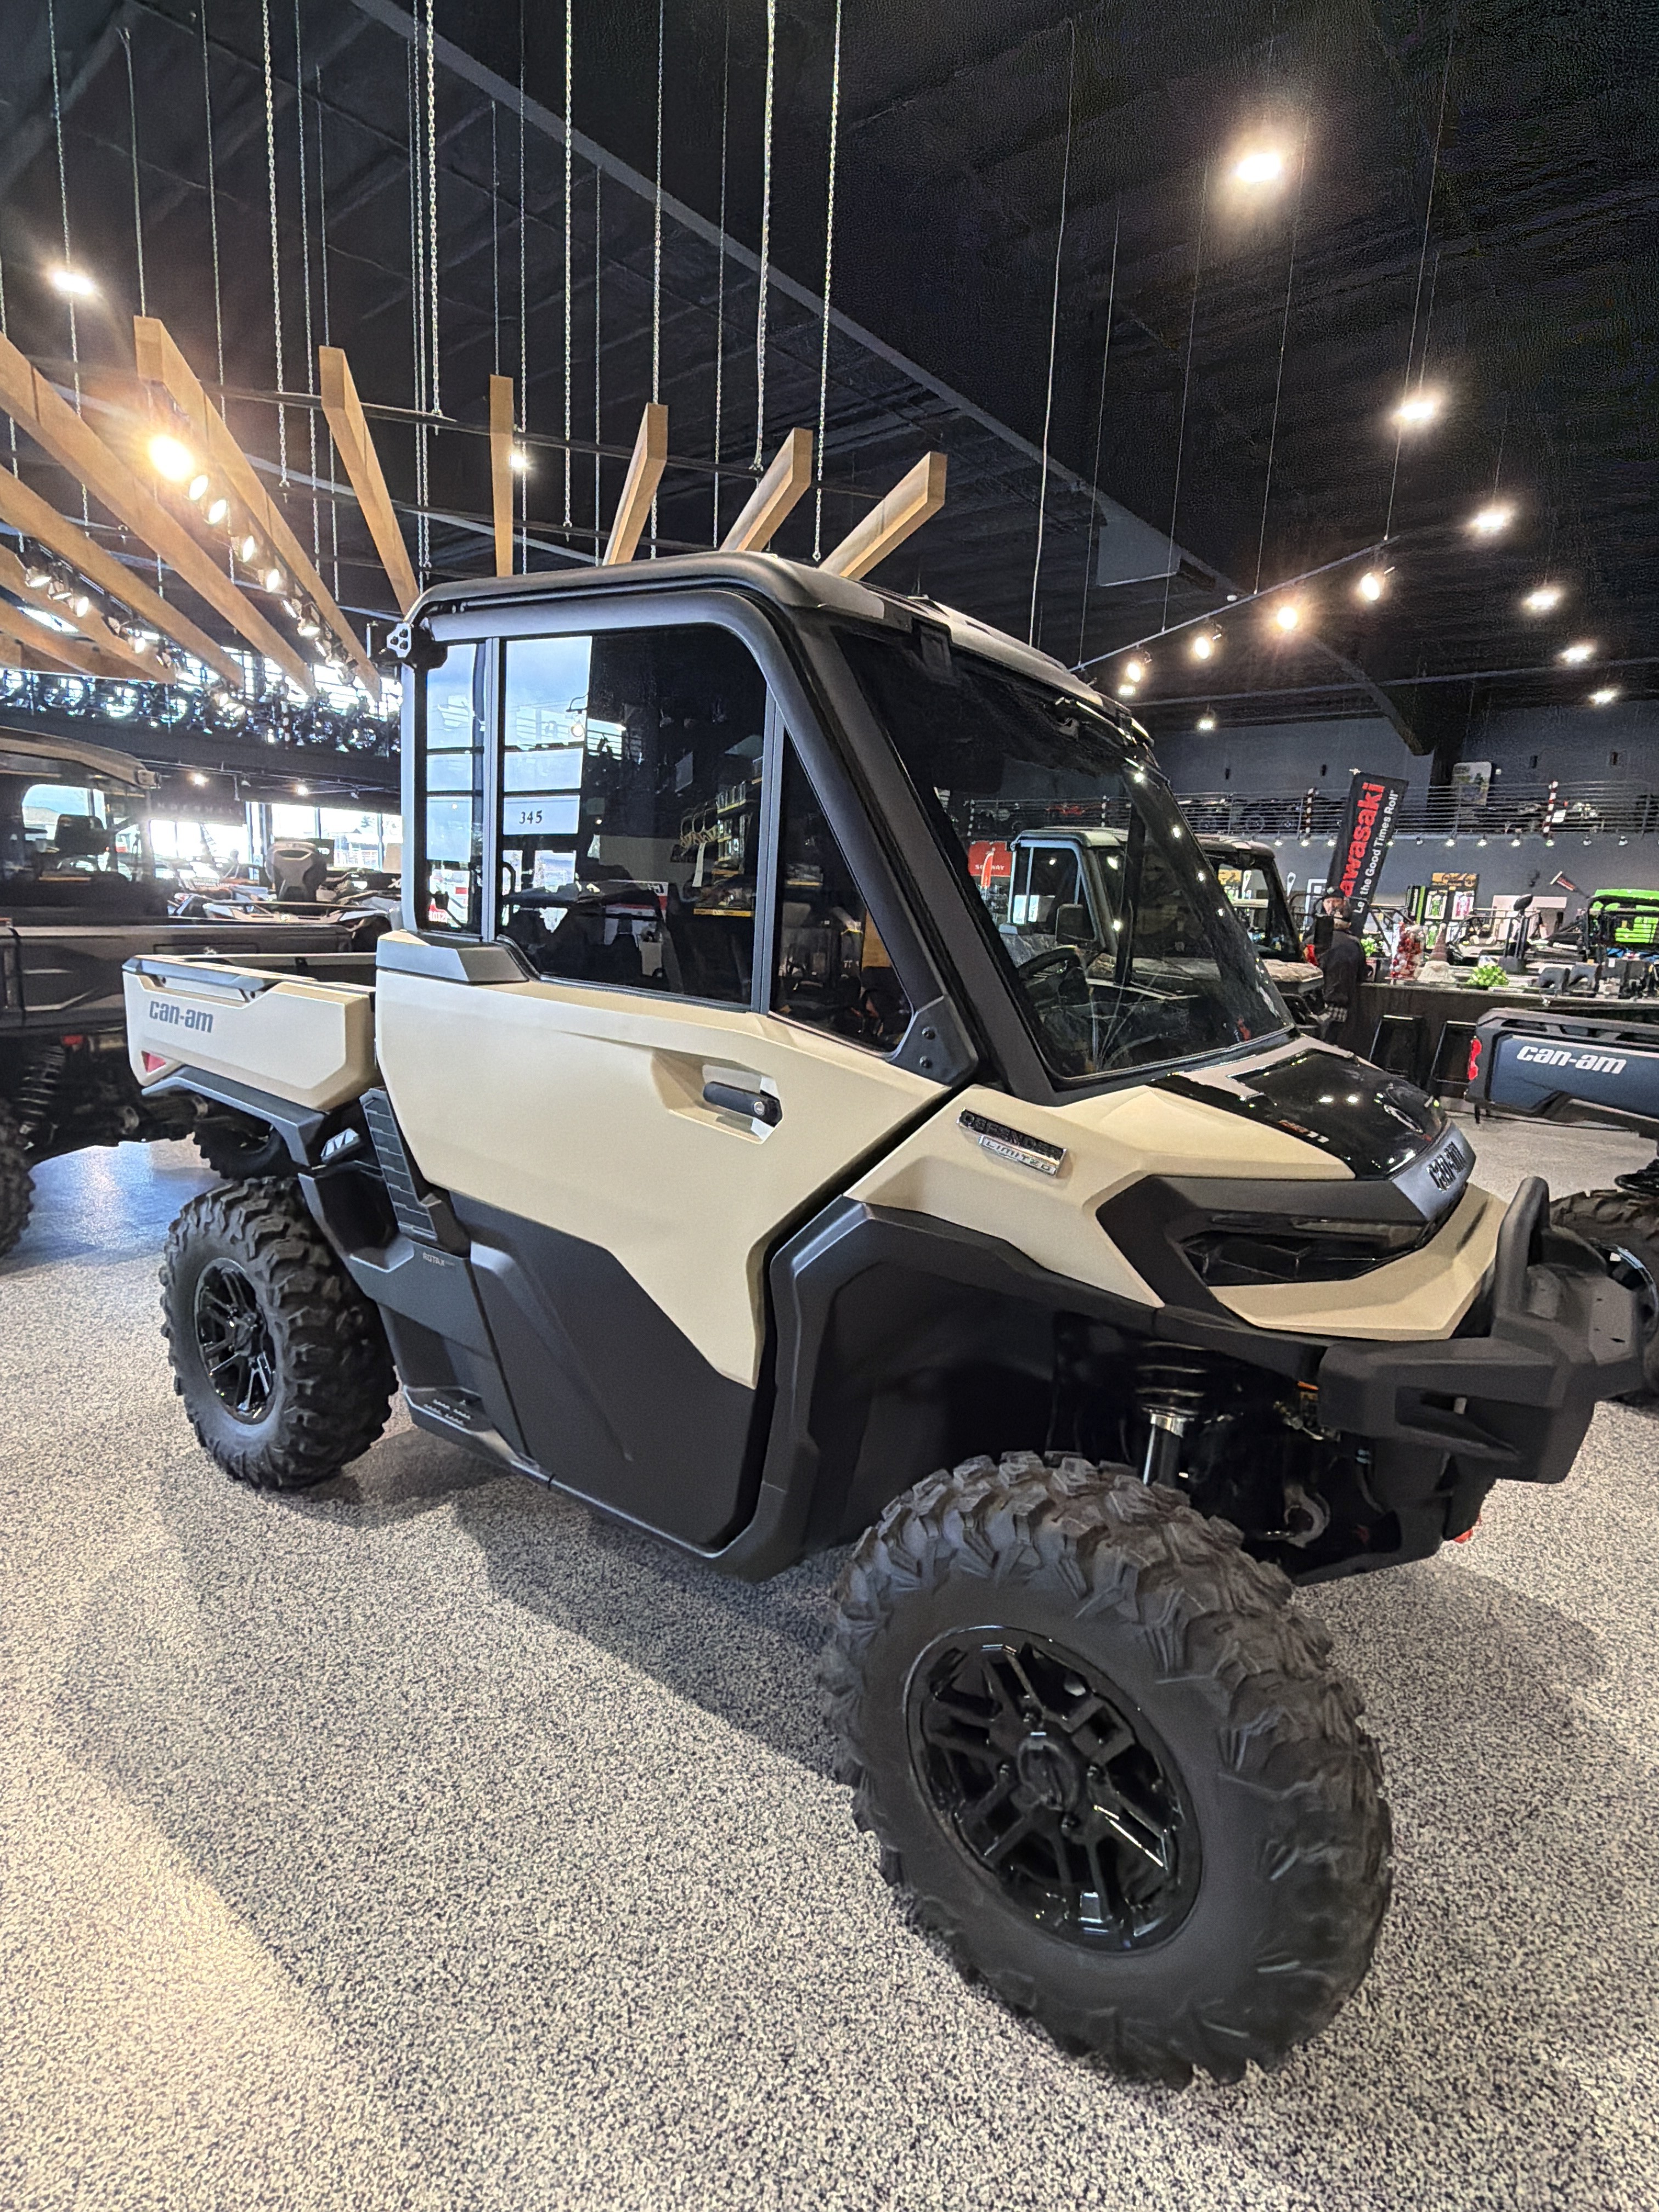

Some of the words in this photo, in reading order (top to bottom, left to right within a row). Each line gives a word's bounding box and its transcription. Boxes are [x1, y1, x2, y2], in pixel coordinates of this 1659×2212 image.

[519, 810, 542, 824] 345
[1340, 782, 1385, 897] awasaki
[1373, 817, 1391, 847] Times
[1365, 849, 1381, 876] Good
[1360, 879, 1372, 895] the
[149, 1001, 213, 1033] can-am
[1516, 1046, 1627, 1074] can-am
[986, 1140, 1051, 1171] LIMITED
